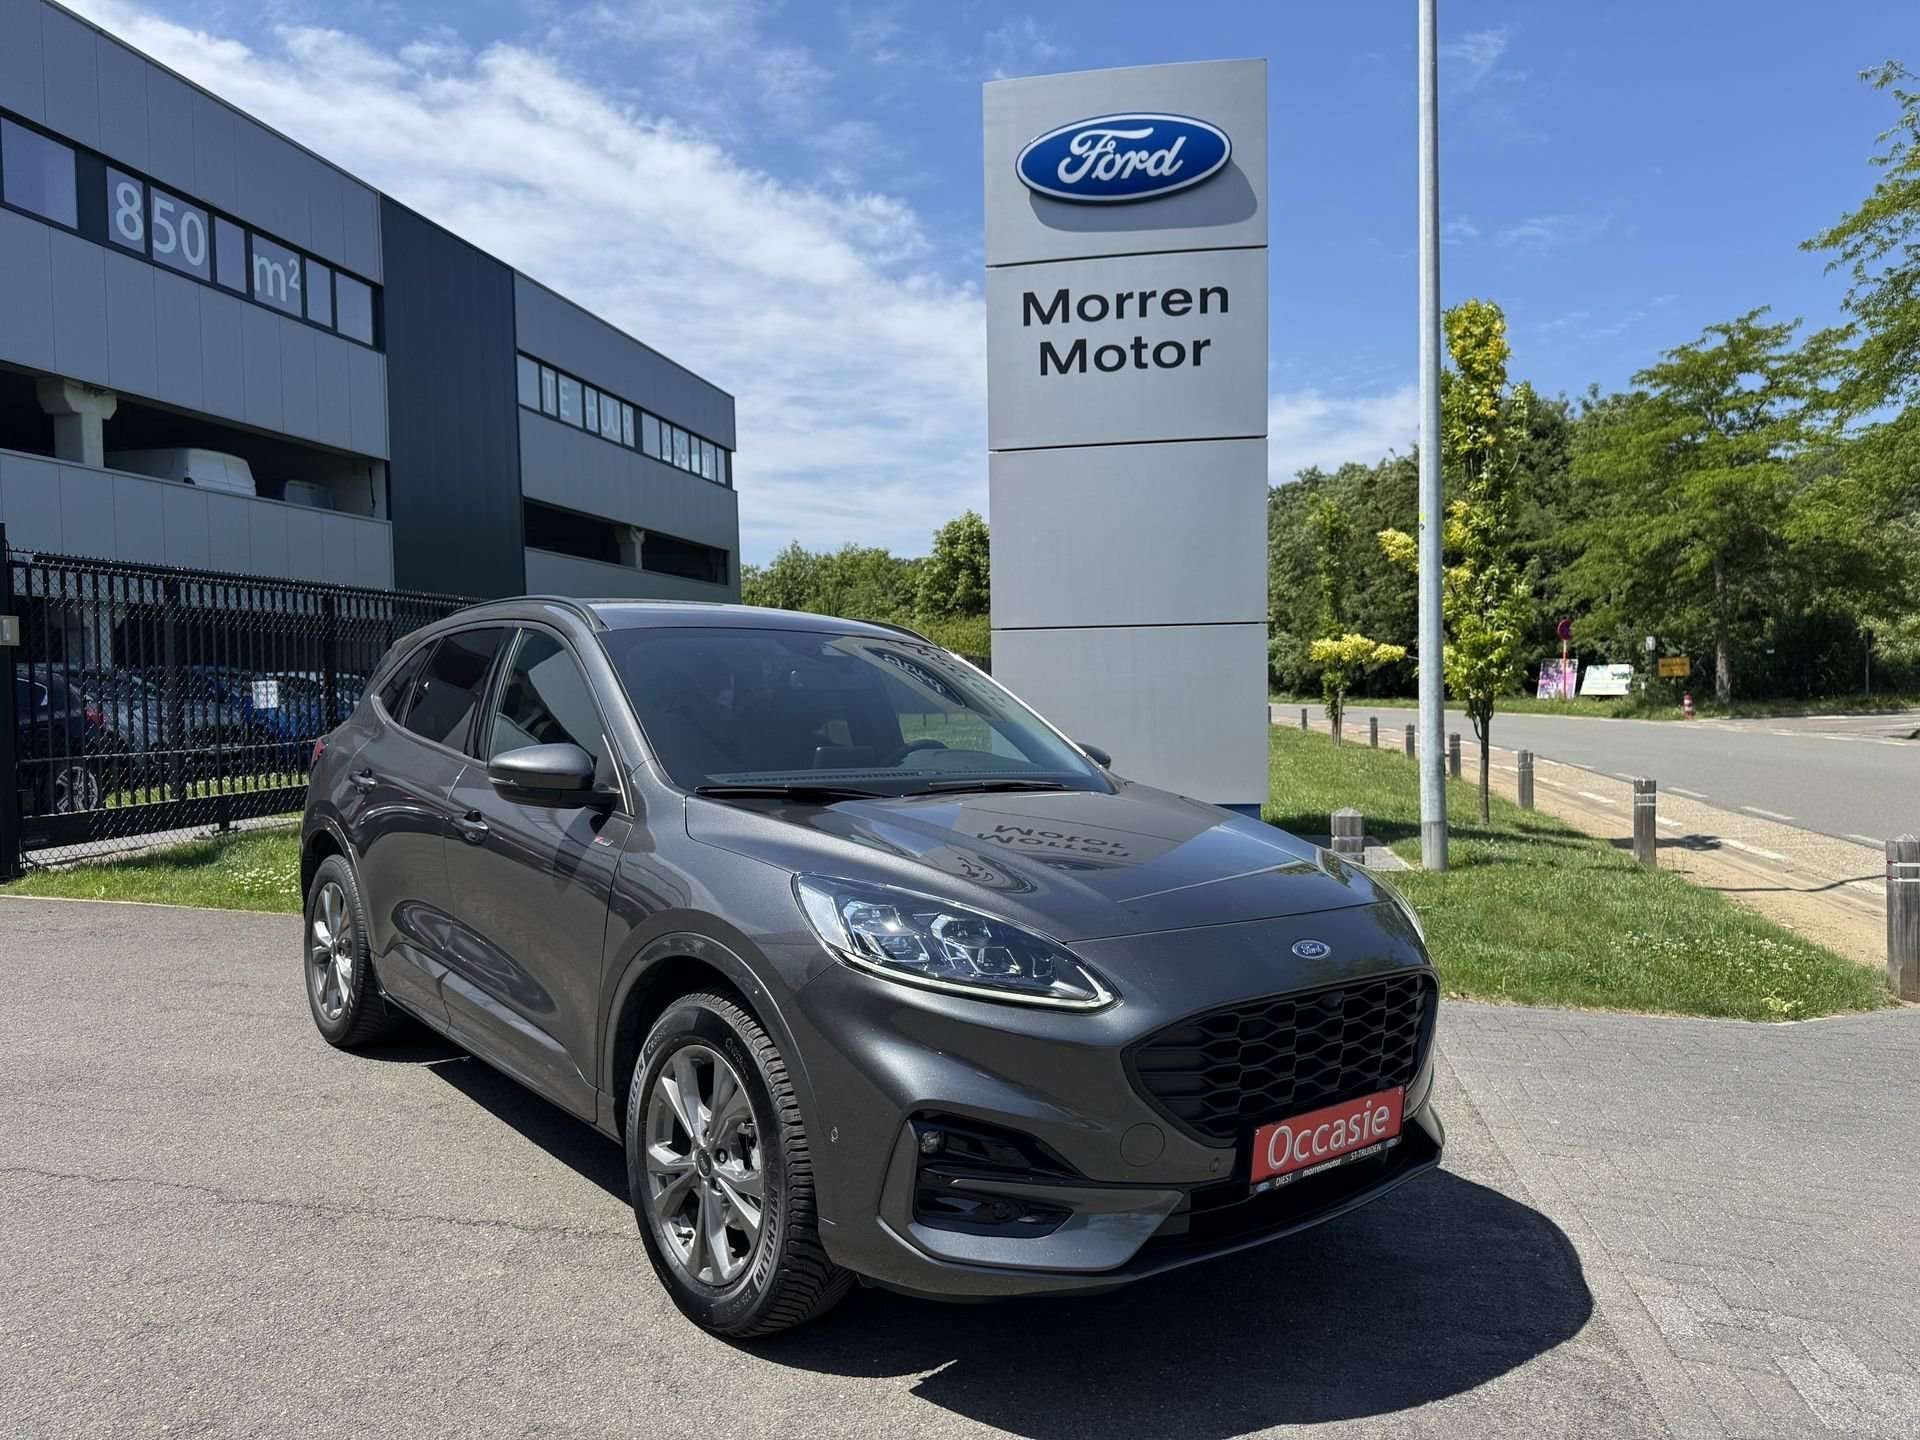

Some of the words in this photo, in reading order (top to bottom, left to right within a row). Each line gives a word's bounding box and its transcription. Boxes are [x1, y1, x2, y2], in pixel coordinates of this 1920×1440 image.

[1057, 127, 1187, 184] Ford
[116, 181, 206, 267] 850
[1022, 285, 1229, 327] Morren
[1040, 336, 1211, 376] Motor
[1268, 1101, 1389, 1170] Occasie
[754, 1186, 779, 1288] MICHELIN
